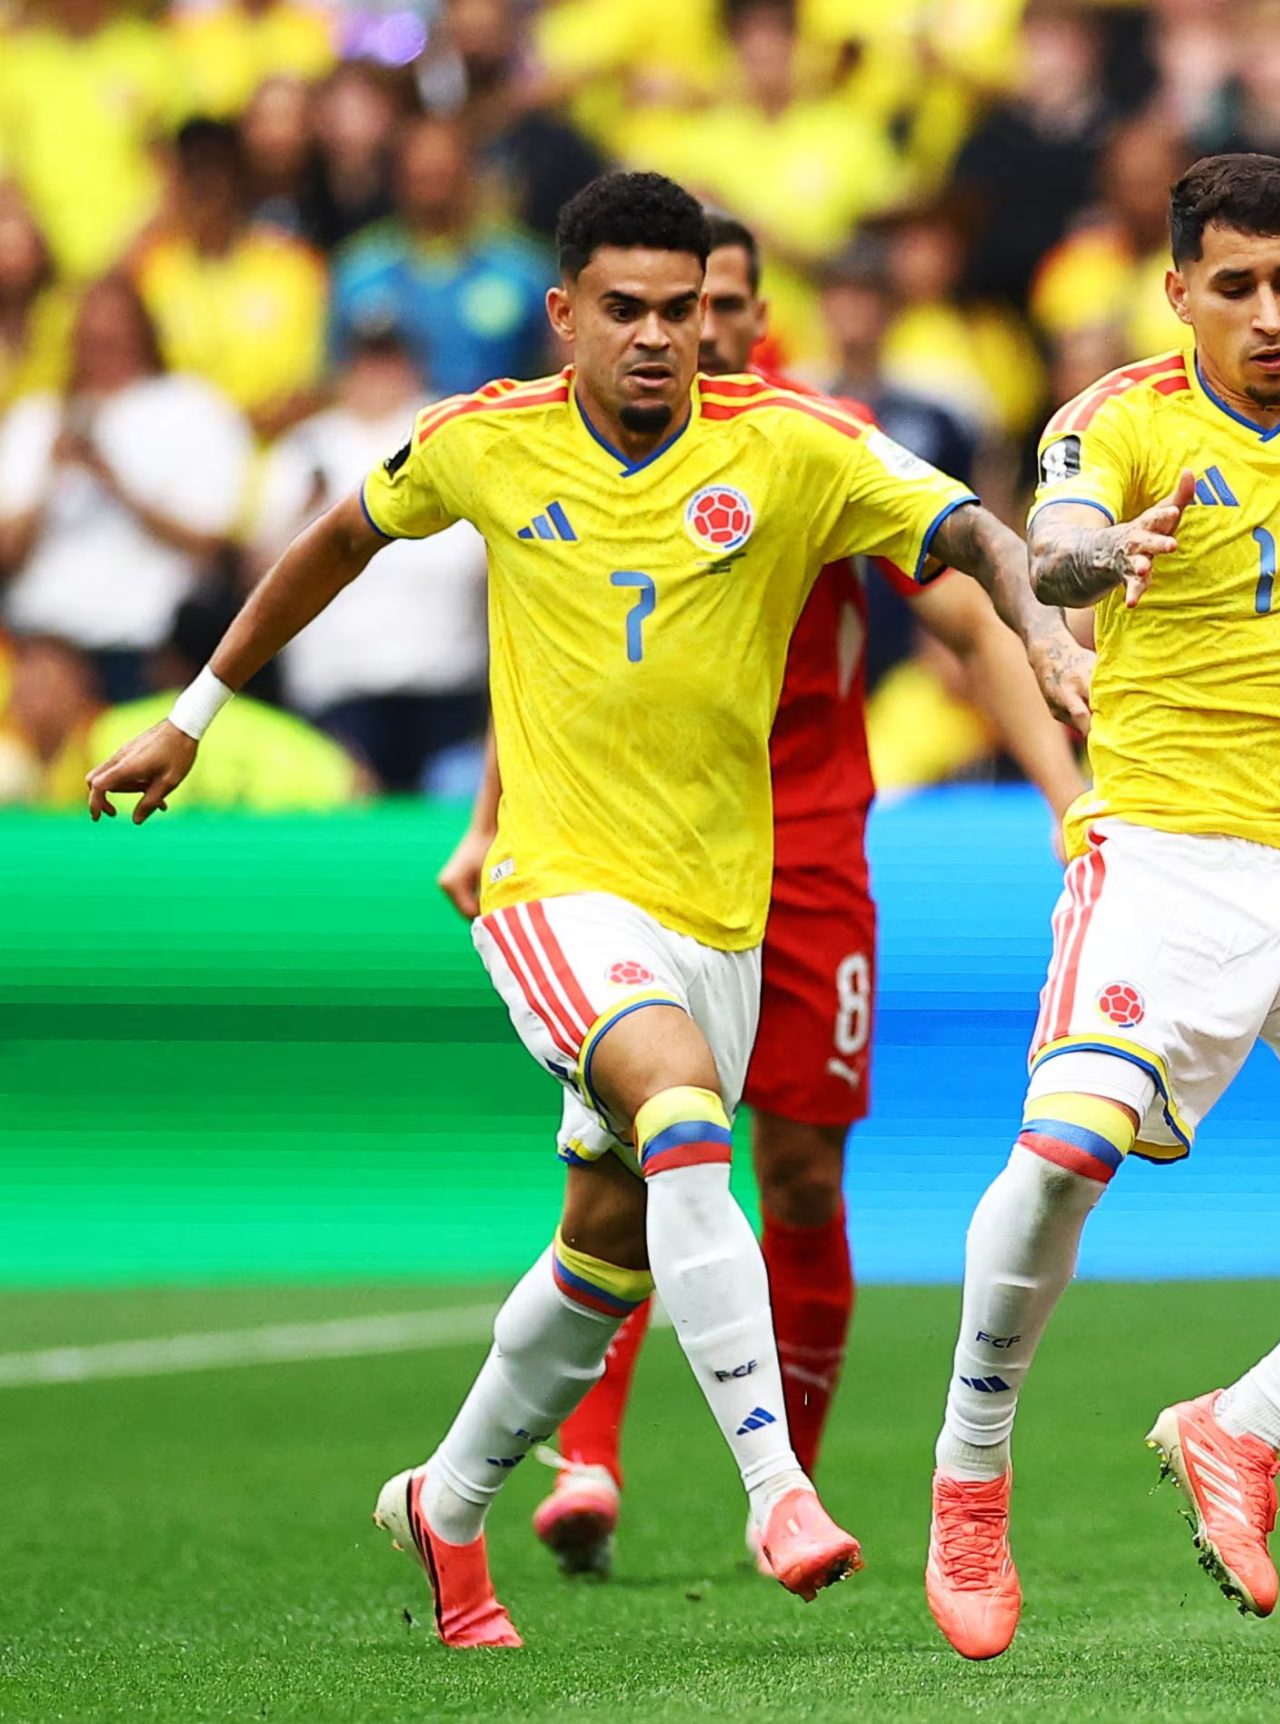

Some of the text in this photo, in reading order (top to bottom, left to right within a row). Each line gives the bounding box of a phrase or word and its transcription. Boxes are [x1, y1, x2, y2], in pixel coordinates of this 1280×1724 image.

[610, 570, 657, 663] 7
[835, 954, 870, 1055] 8
[975, 1330, 1021, 1348] FCF
[713, 1359, 758, 1383] FCF
